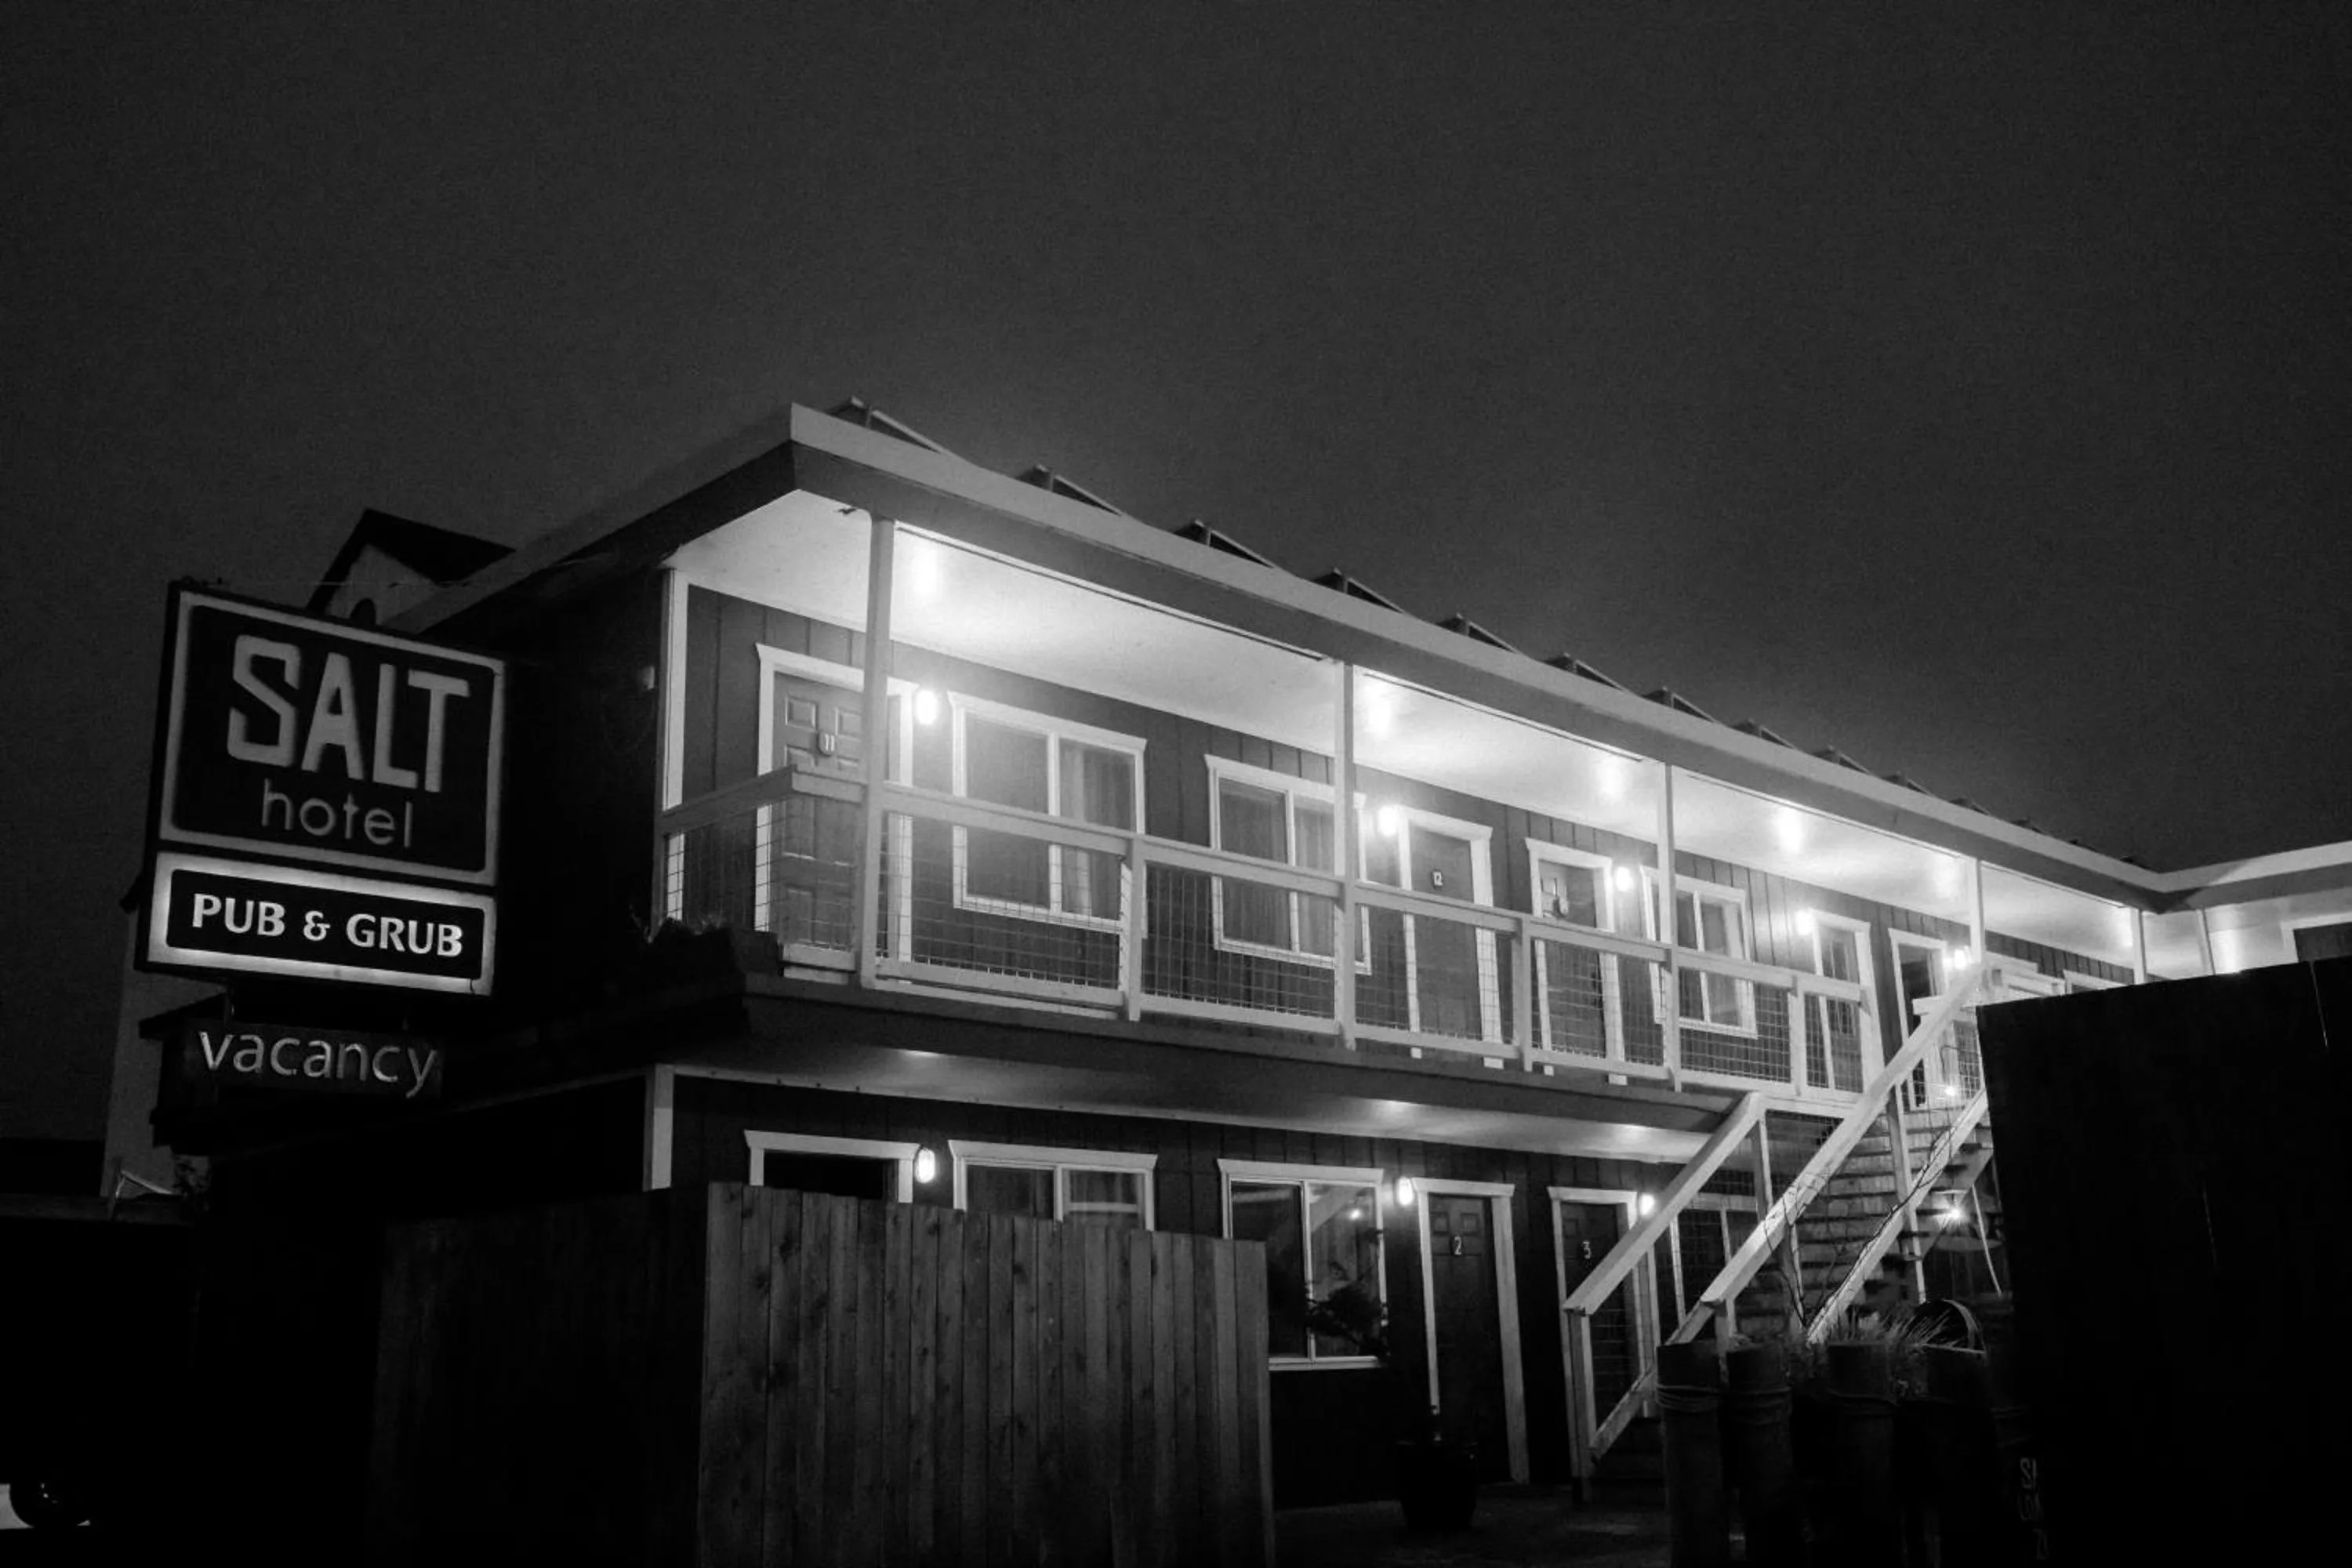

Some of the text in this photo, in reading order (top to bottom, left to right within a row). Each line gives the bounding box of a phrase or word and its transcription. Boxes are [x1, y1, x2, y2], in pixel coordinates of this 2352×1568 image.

[227, 634, 470, 793] SALT
[260, 778, 413, 848] hotel
[191, 892, 463, 958] PUB & GRUB
[198, 1030, 437, 1098] vacancy
[1454, 1236, 1463, 1255] 2
[1581, 1240, 1592, 1259] 3
